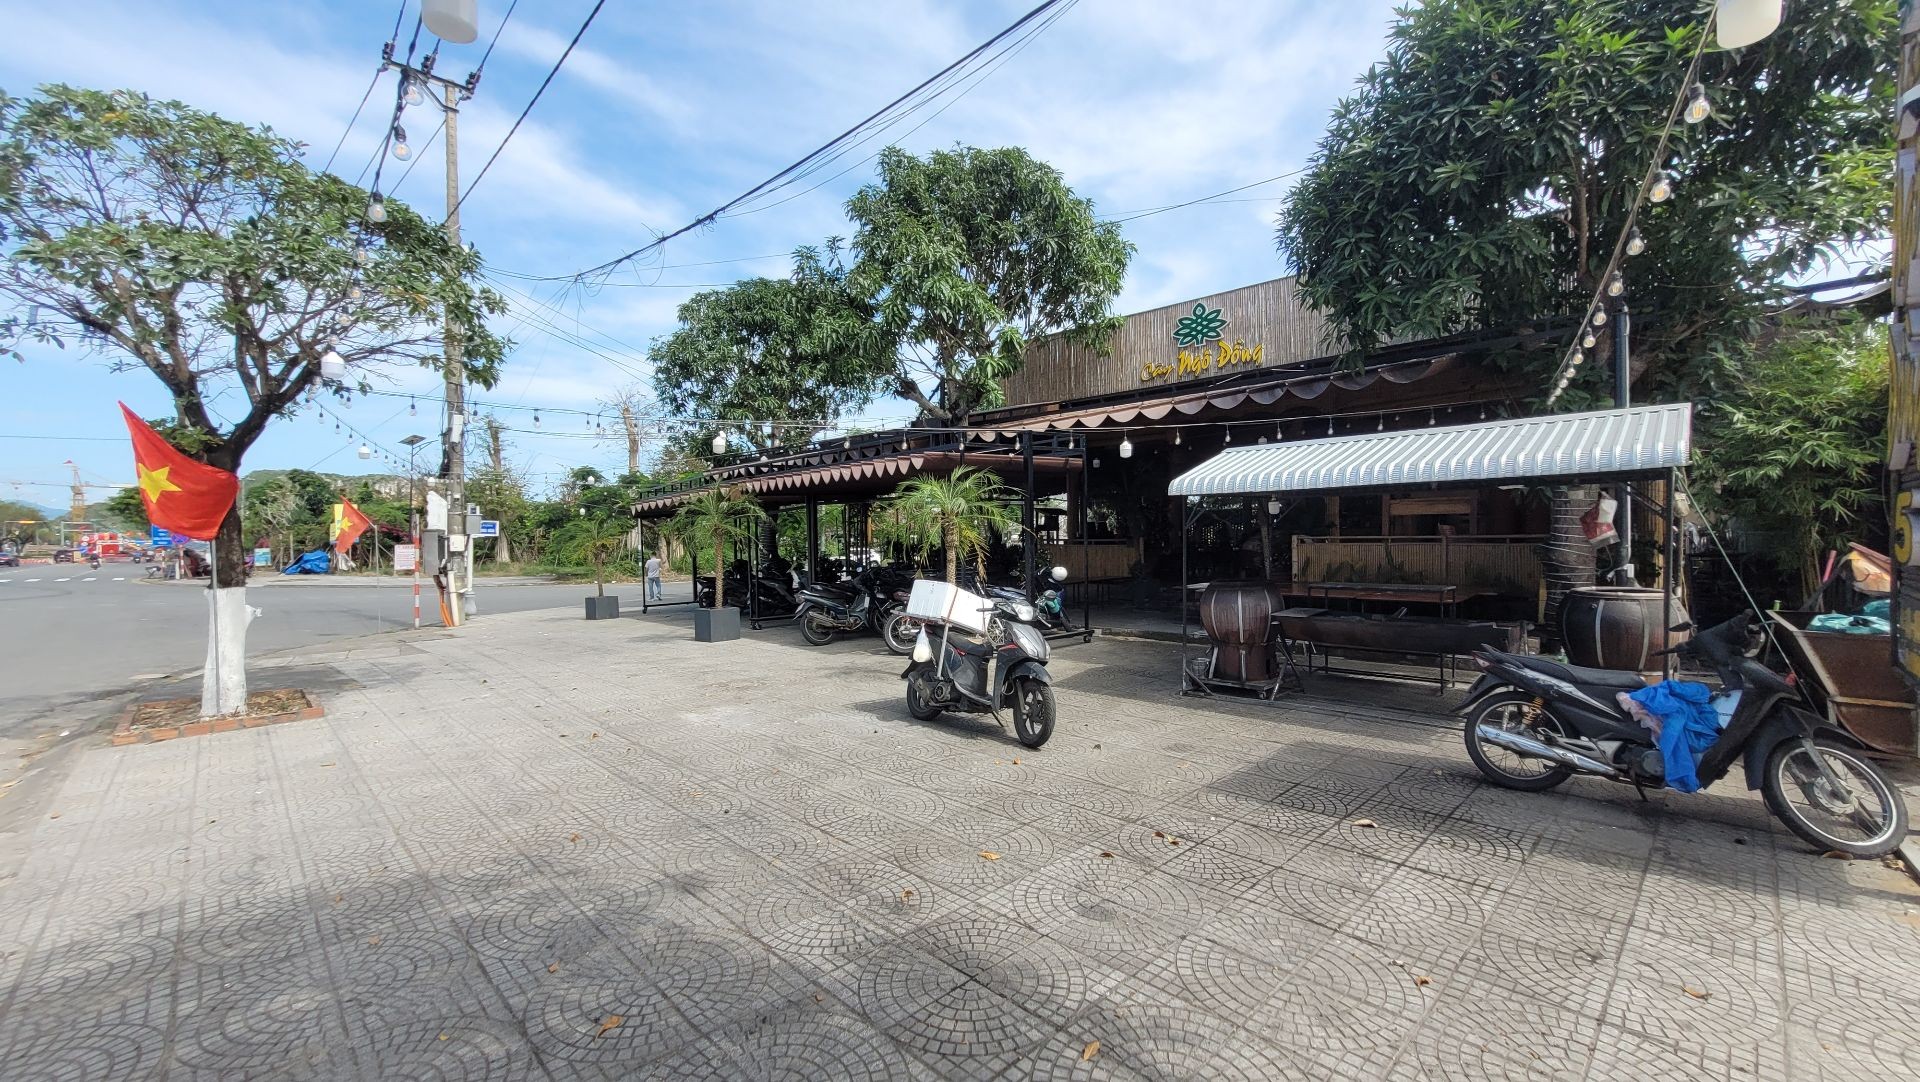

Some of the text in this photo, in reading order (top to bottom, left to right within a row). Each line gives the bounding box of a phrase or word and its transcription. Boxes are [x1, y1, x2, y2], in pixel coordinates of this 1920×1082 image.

[1141, 339, 1263, 381] Cây Ngô Đồng
